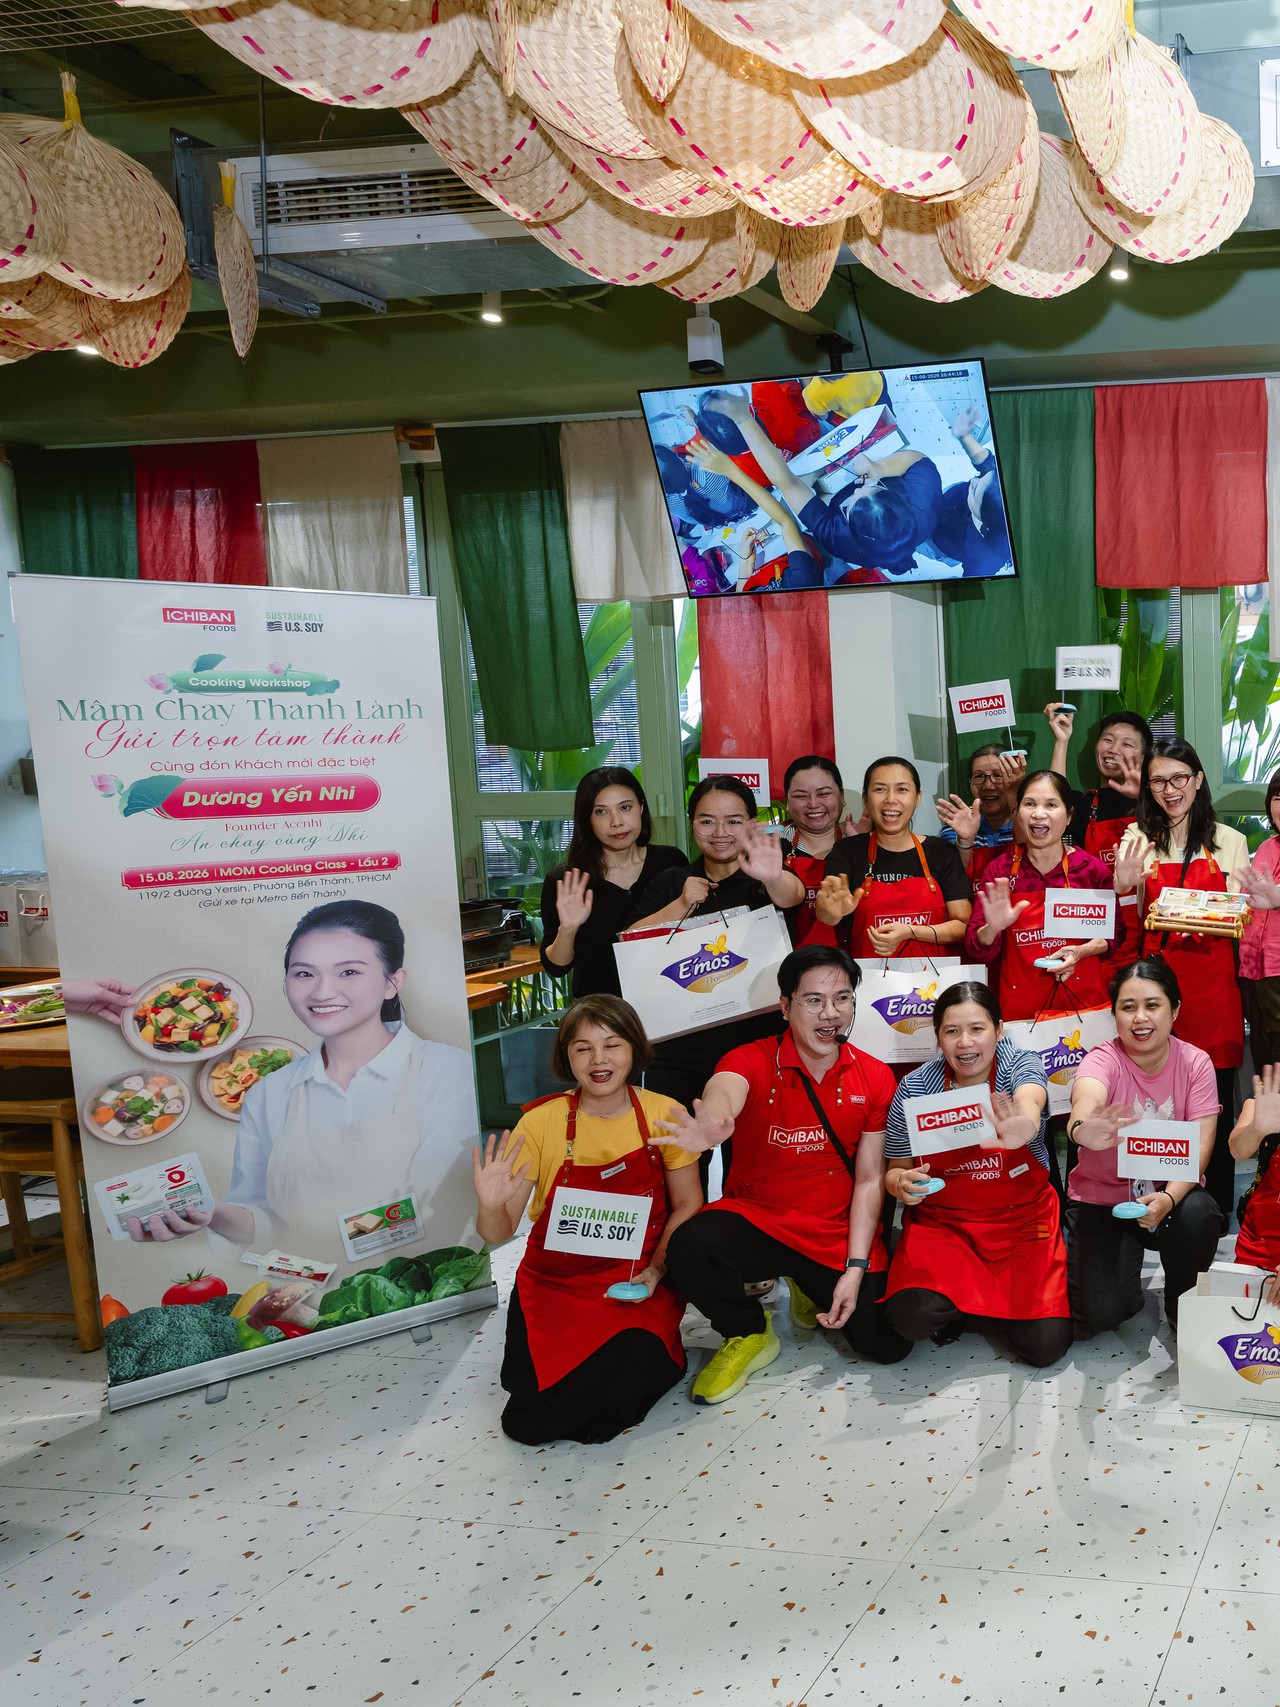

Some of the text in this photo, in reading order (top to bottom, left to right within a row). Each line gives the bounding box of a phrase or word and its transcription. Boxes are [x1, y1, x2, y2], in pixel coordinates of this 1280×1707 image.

[166, 610, 232, 623] ICHIBAN
[266, 612, 324, 622] SUSTAINABLE
[202, 624, 237, 632] FOODS
[284, 622, 324, 633] U.S. SOY
[188, 678, 311, 689] Cooking Workshop
[960, 697, 1004, 712] ICHIBAN
[56, 698, 424, 727] Mâm Chay Thanh Lành
[984, 708, 1007, 717] FOODS
[84, 718, 408, 759] Gửi trọn tâm thành
[150, 756, 376, 773] Cùng đón Khách mời đặc biệt
[182, 784, 356, 808] Dương Yến Nhi
[224, 821, 278, 832] Founder
[220, 832, 270, 855] chay
[275, 834, 320, 851] cùng
[139, 856, 388, 883] 15.08.2026 MOM Cooking Class Lầu 2
[139, 890, 170, 900] 119/2
[214, 884, 250, 894] Yersin,
[298, 879, 318, 888] Bến
[320, 876, 354, 886] Thành,
[356, 874, 392, 882] TPHCM
[224, 898, 238, 906] xe
[256, 894, 288, 904] Metro
[290, 892, 310, 900] Bến
[1055, 905, 1104, 917] ICHIBAN
[1016, 930, 1046, 943] ICHI
[1042, 938, 1067, 950] FOODS
[678, 954, 730, 980] E'mos
[886, 998, 935, 1017] E'mos
[1040, 1050, 1084, 1070] E'mos
[919, 1106, 980, 1128] ICHIBAN
[954, 1120, 984, 1133] FOODS
[772, 1128, 826, 1144] ICHIBAN
[796, 1143, 825, 1154] FOODS
[1129, 1140, 1186, 1154] ICHIBAN
[1159, 1158, 1190, 1166] FOODS
[971, 1172, 1000, 1180] FOODS
[561, 1204, 639, 1224] SUSTAINABLE
[580, 1222, 636, 1242] U.S. SOY
